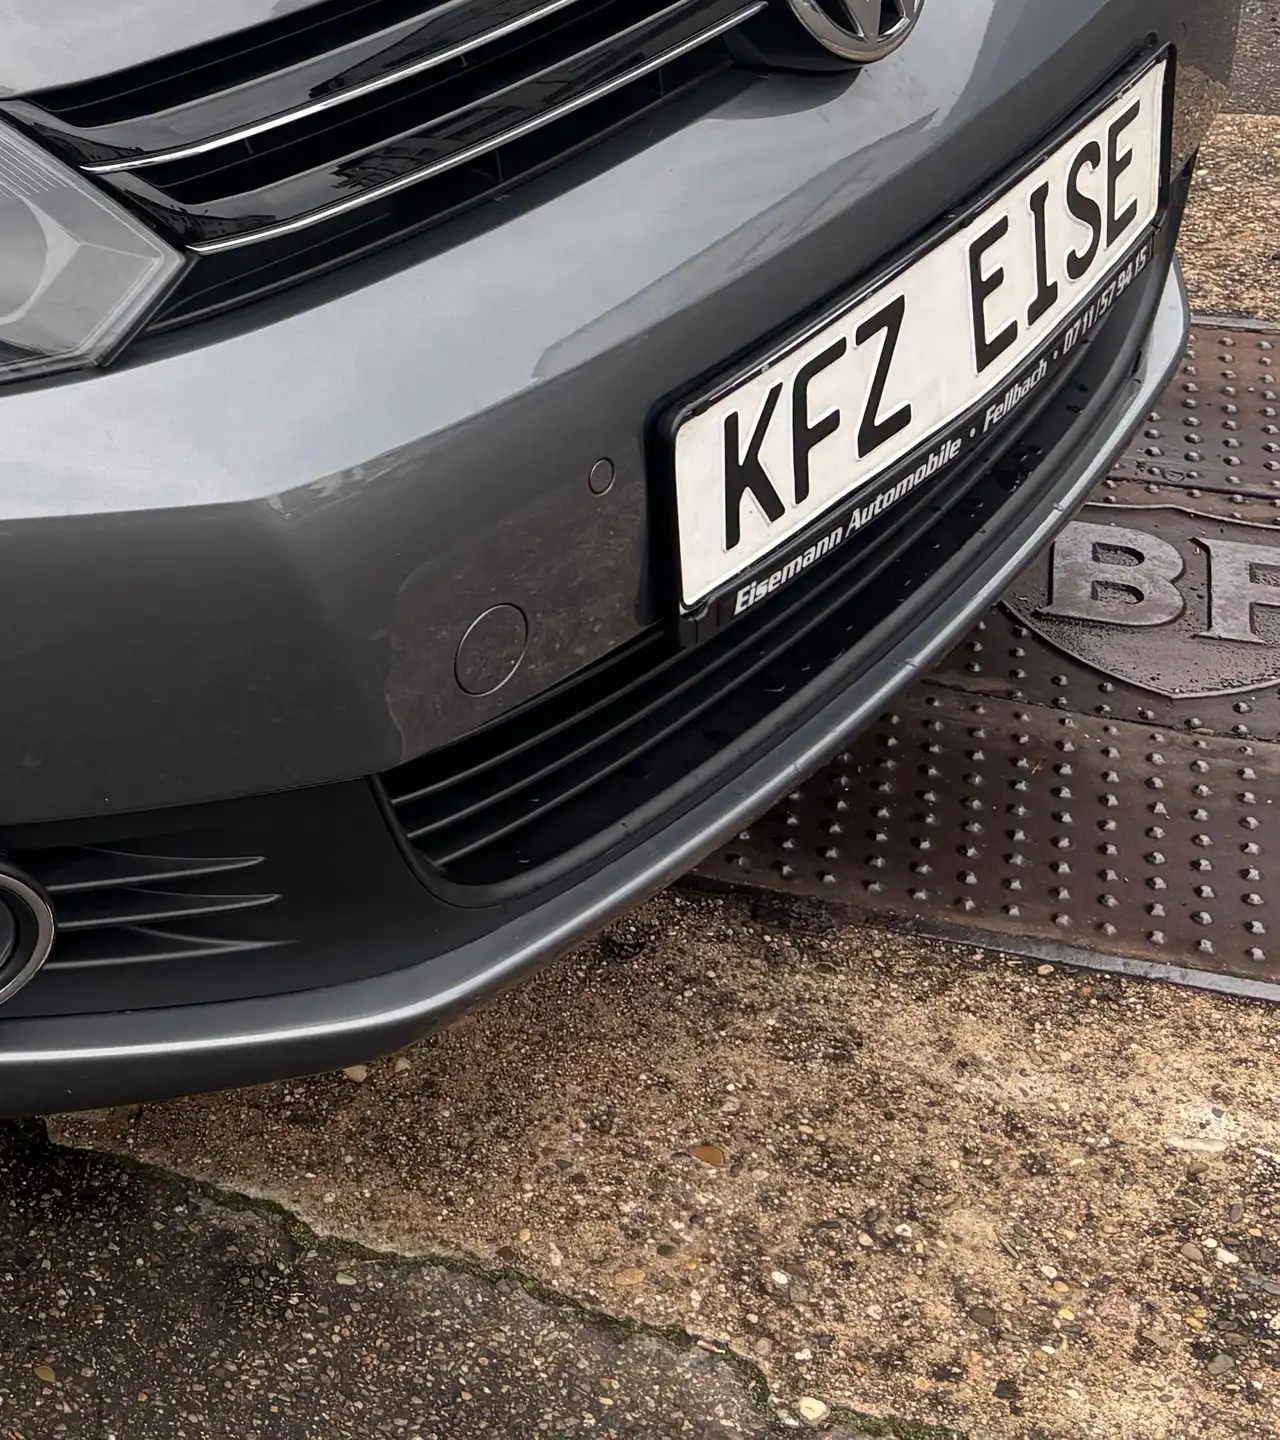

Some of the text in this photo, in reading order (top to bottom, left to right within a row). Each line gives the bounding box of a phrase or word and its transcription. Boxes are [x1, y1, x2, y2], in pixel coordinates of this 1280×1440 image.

[724, 97, 1141, 551] KFZ EISE
[734, 526, 843, 616] Eisemann
[845, 437, 963, 537] Automobile
[983, 358, 1048, 435] Fellbach
